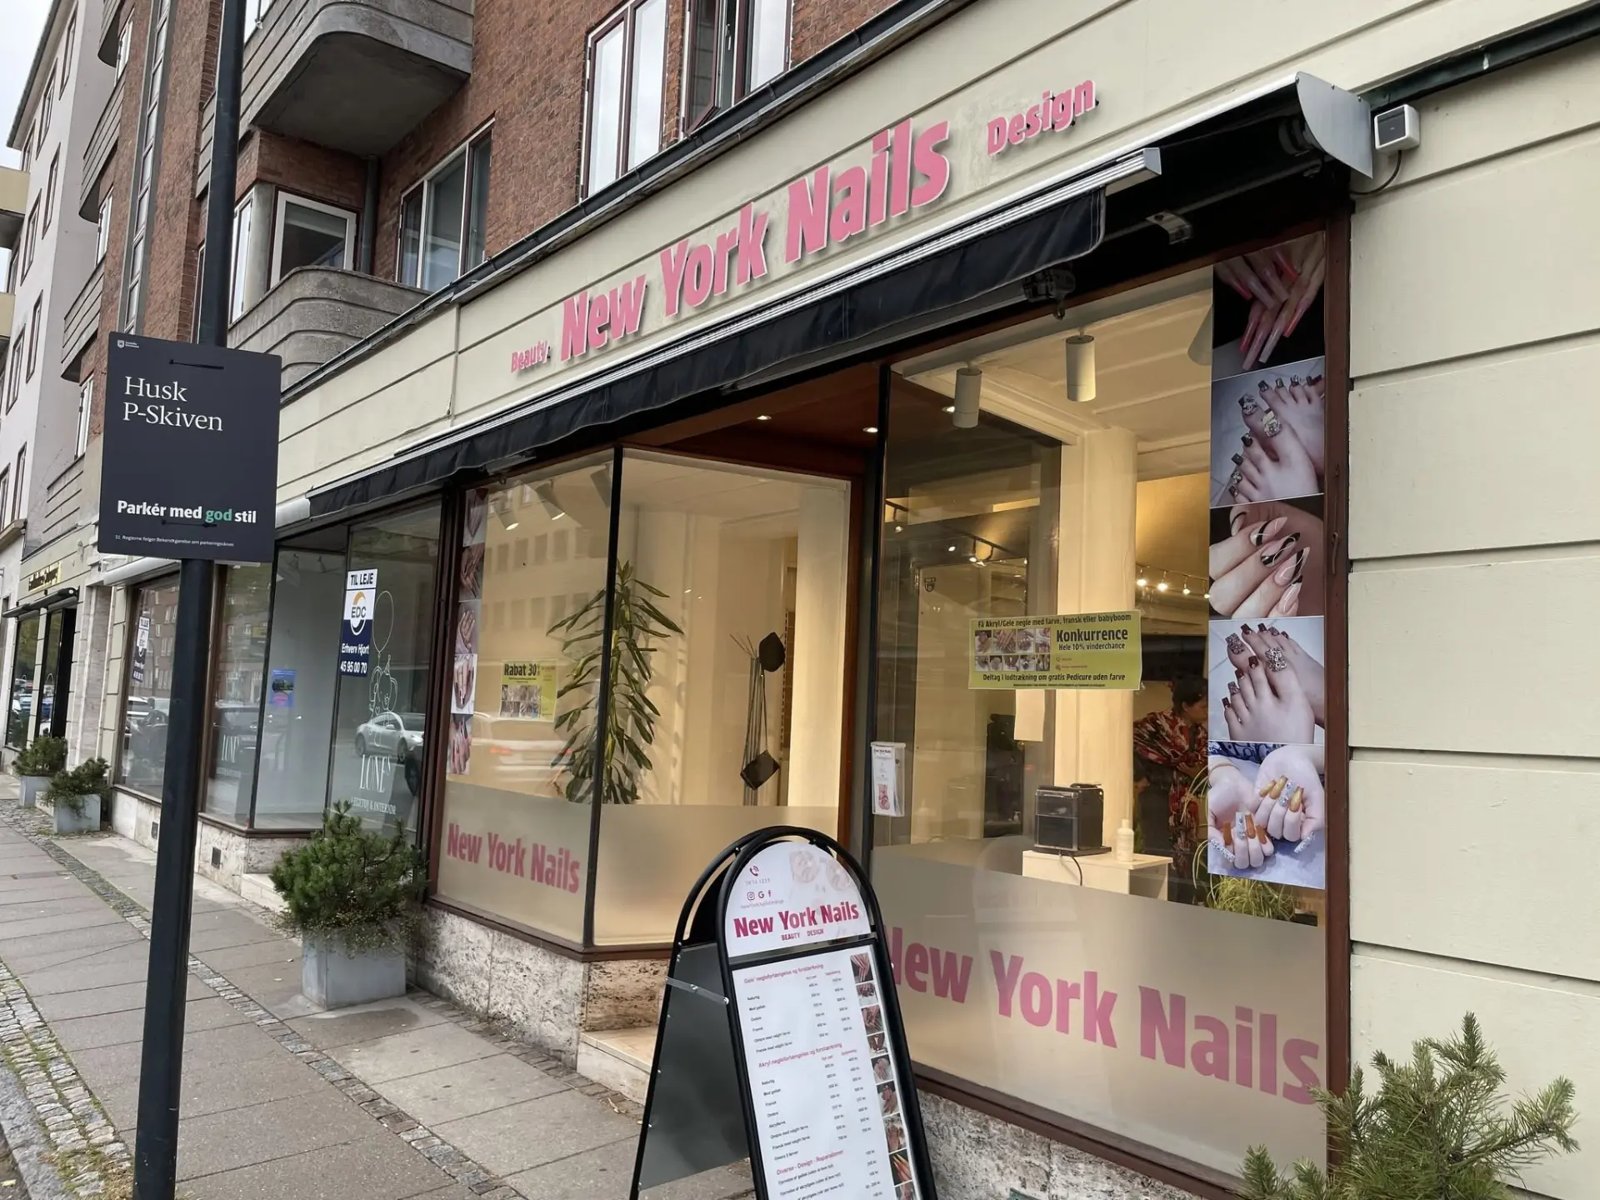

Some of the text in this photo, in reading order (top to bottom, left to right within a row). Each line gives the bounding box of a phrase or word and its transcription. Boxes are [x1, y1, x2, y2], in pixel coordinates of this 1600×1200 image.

[511, 79, 1096, 373] Beauty New York Nails Design
[124, 376, 188, 402] Husk
[122, 401, 223, 432] P-Skiven
[117, 500, 257, 524] Parkér med god stil
[350, 573, 374, 585] TIL LEJE
[351, 606, 367, 618] EDC
[1015, 619, 1031, 627] negle
[1063, 616, 1080, 624] fransk
[1083, 615, 1097, 623] eller
[1098, 614, 1132, 623] babyboom
[1056, 628, 1128, 642] Konkurrence
[1058, 642, 1125, 651] Hele 10% vinderchance
[360, 662, 368, 674] 70
[504, 663, 527, 676] Rabat
[528, 663, 540, 676] 30
[983, 673, 1000, 682] Deltag
[1004, 673, 1037, 682] lodtrækning
[1048, 673, 1065, 682] gratis
[1066, 673, 1091, 681] Pedicure
[1093, 673, 1108, 681] uden
[447, 823, 580, 894] New York Nails
[733, 901, 860, 938] New York Nails
[781, 928, 824, 942] BEAUTY DESIGN
[989, 949, 1118, 1049] York
[1138, 985, 1320, 1106] Nails
